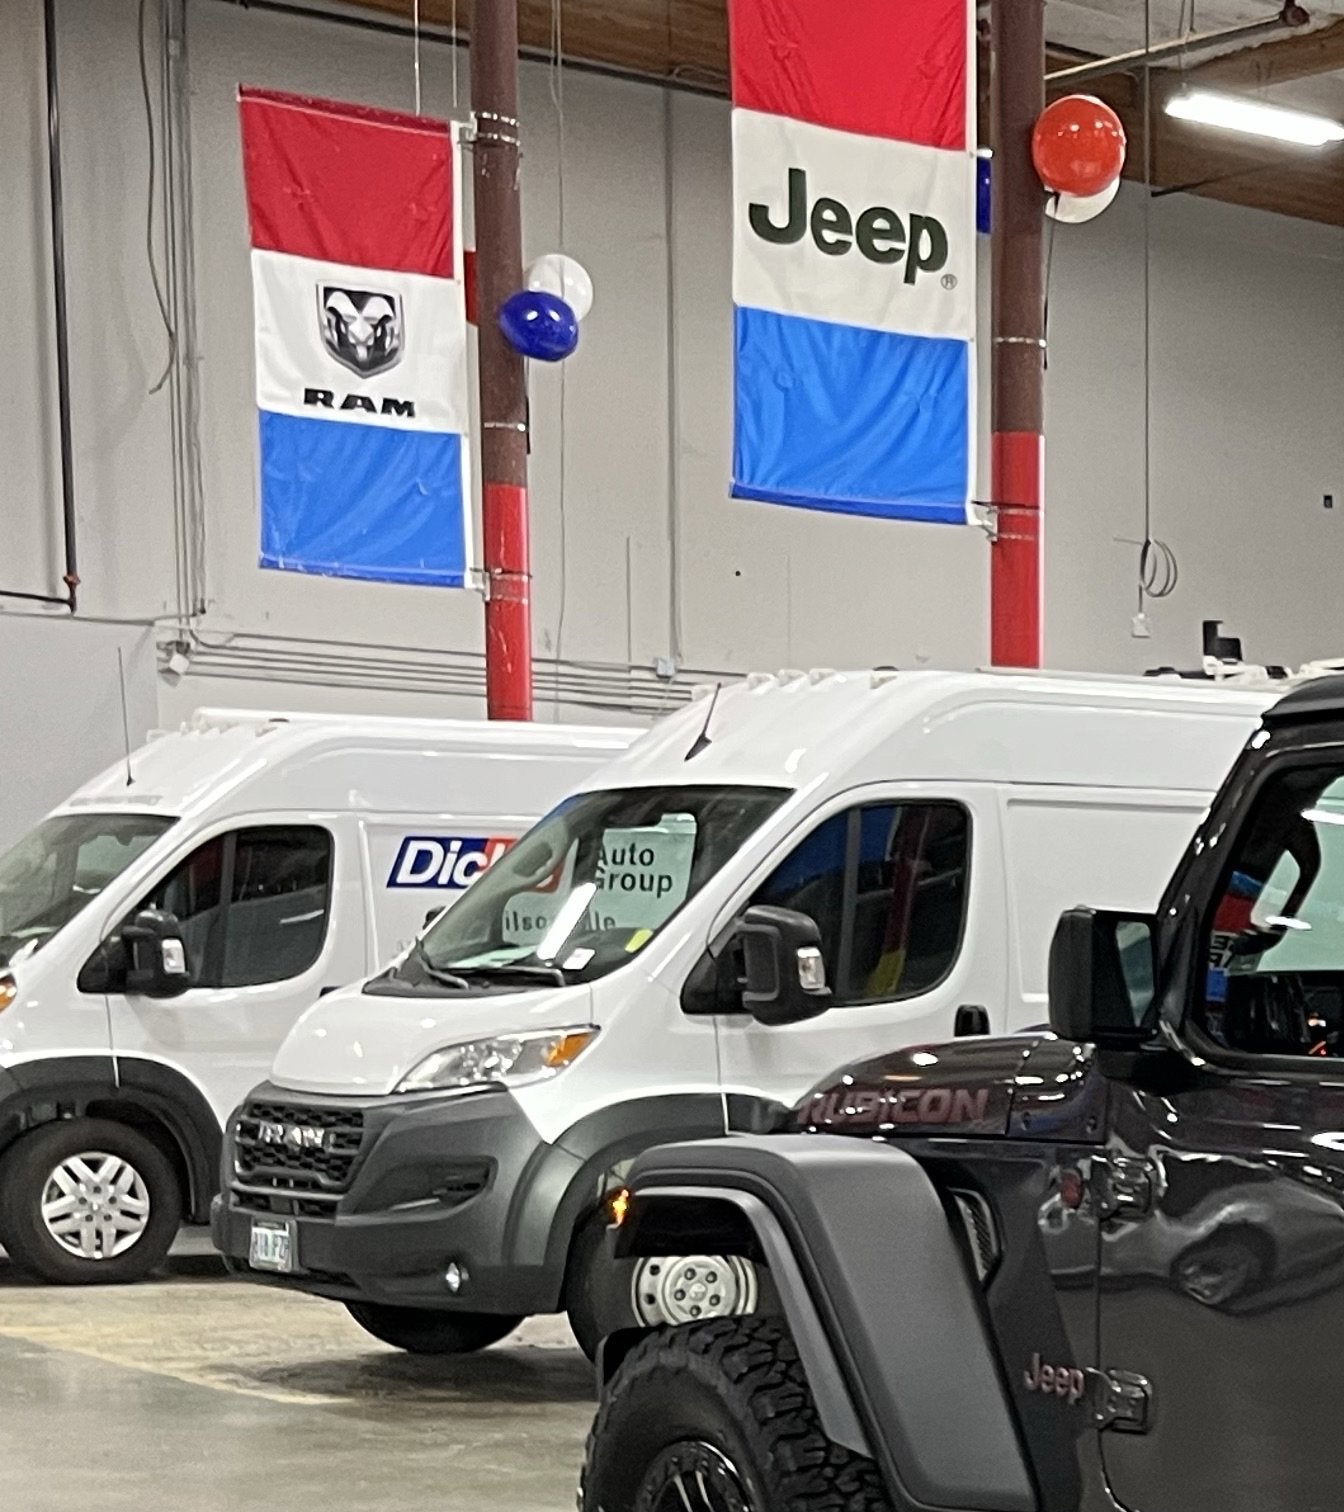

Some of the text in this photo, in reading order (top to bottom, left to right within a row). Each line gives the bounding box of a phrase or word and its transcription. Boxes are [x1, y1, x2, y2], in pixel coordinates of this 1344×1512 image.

[748, 168, 948, 285] Jeep
[304, 388, 415, 417] RAM
[797, 1088, 989, 1126] RUBICON
[1024, 1352, 1084, 1405] Jeep
